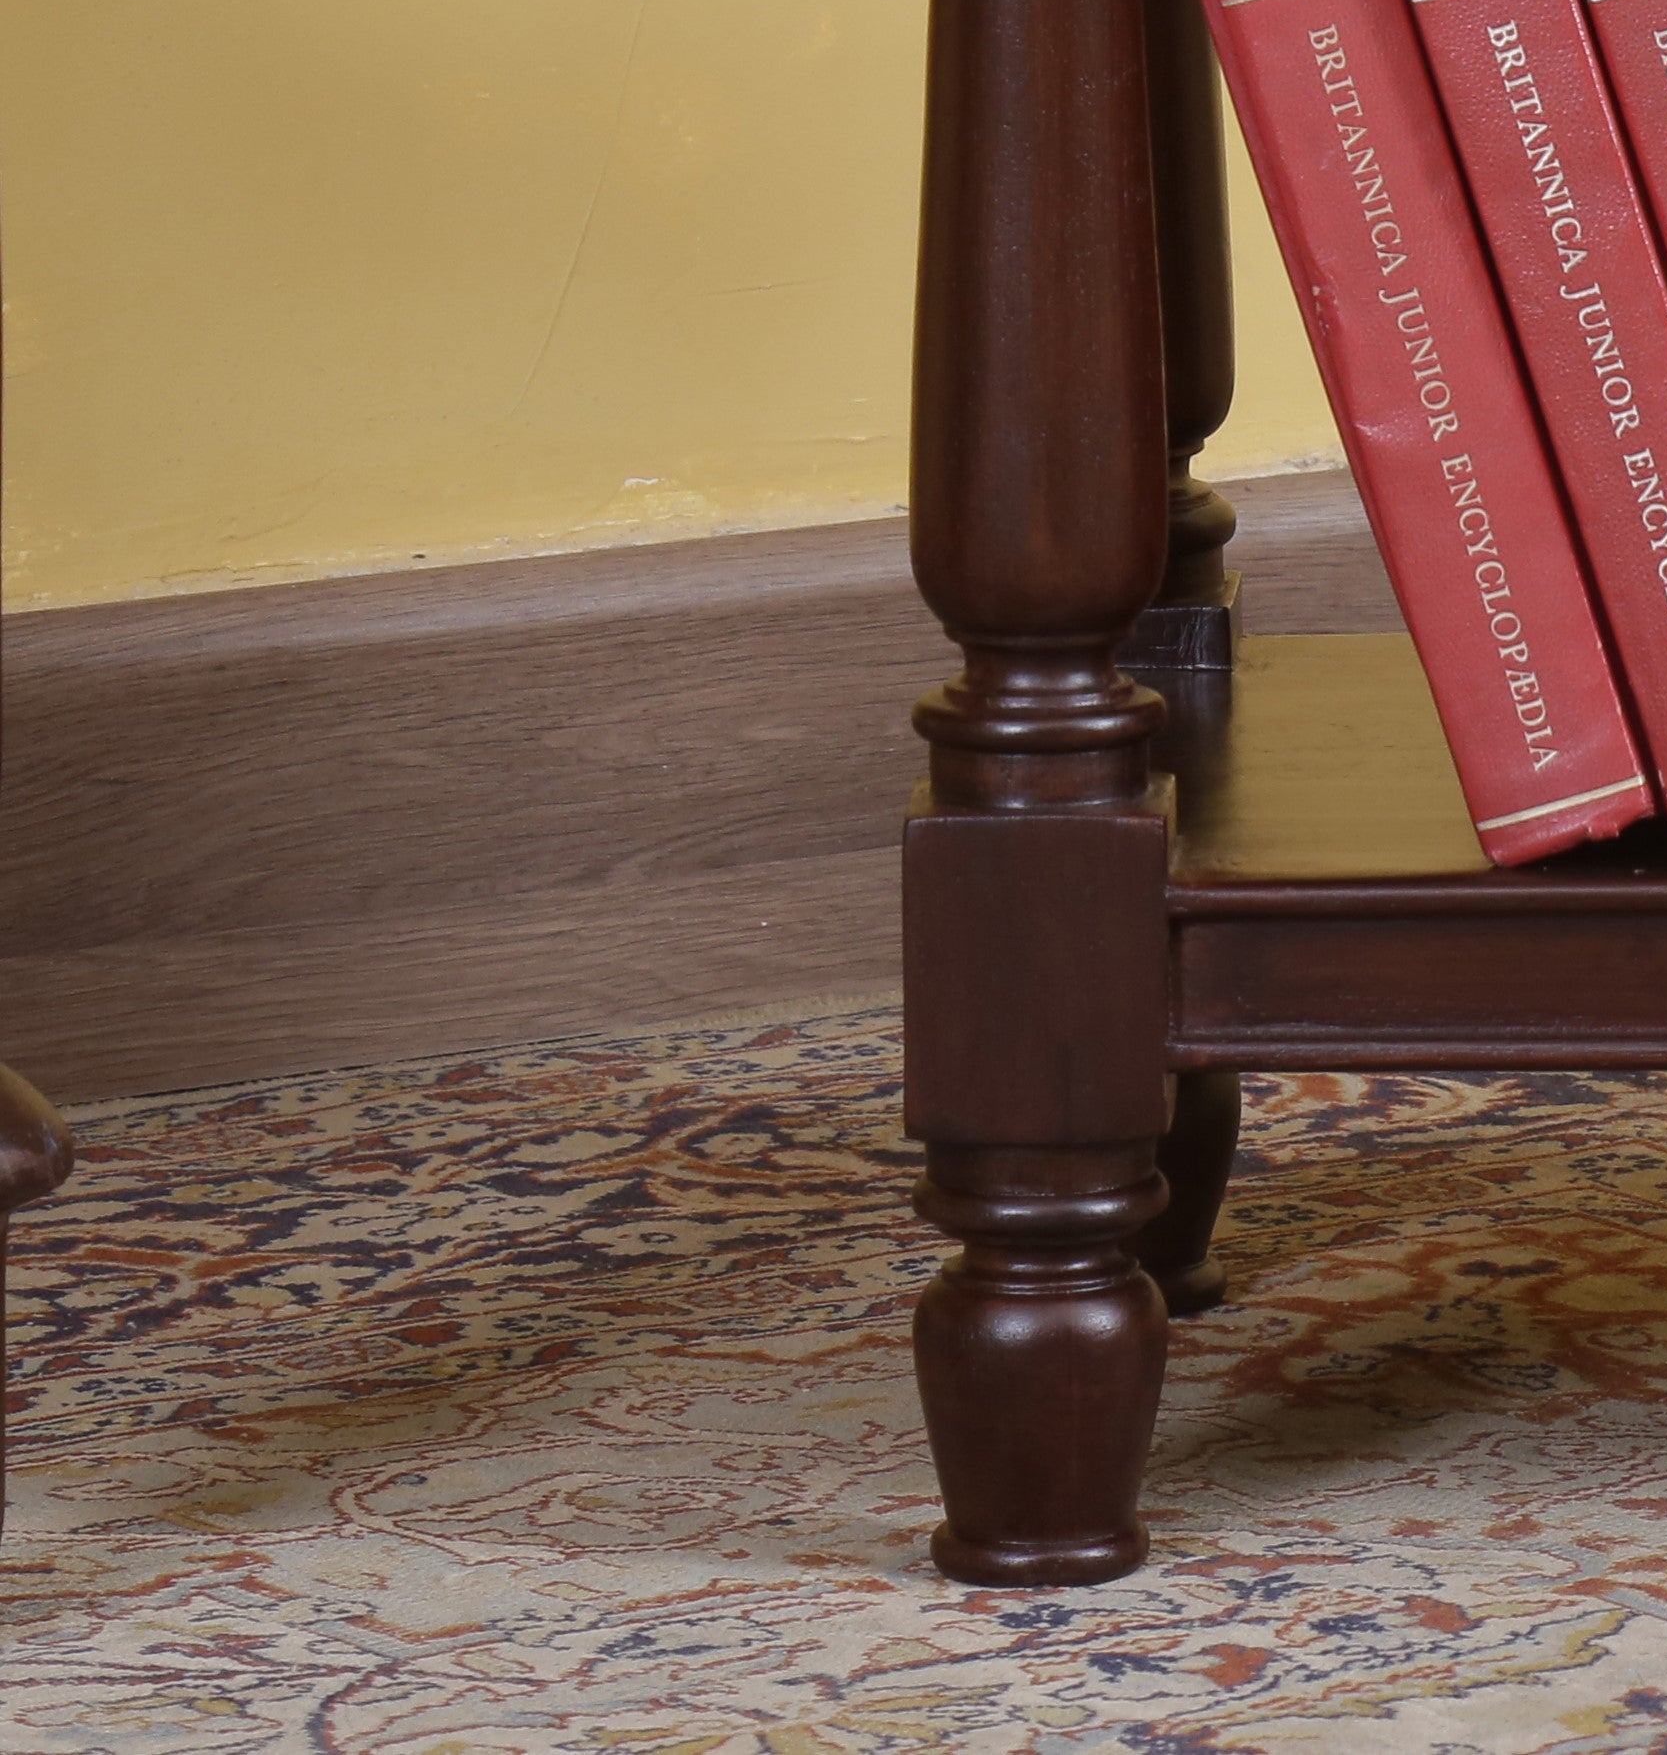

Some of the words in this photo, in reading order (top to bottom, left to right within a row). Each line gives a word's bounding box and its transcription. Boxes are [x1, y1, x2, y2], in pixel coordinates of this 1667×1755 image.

[1309, 24, 1407, 276] BRITANNICA
[1379, 288, 1459, 442] JUNIOR
[1441, 453, 1562, 774] ENCYCLOPÆDIA
[1487, 20, 1588, 273] BRITANNICA
[1560, 282, 1640, 439] JUNIOR
